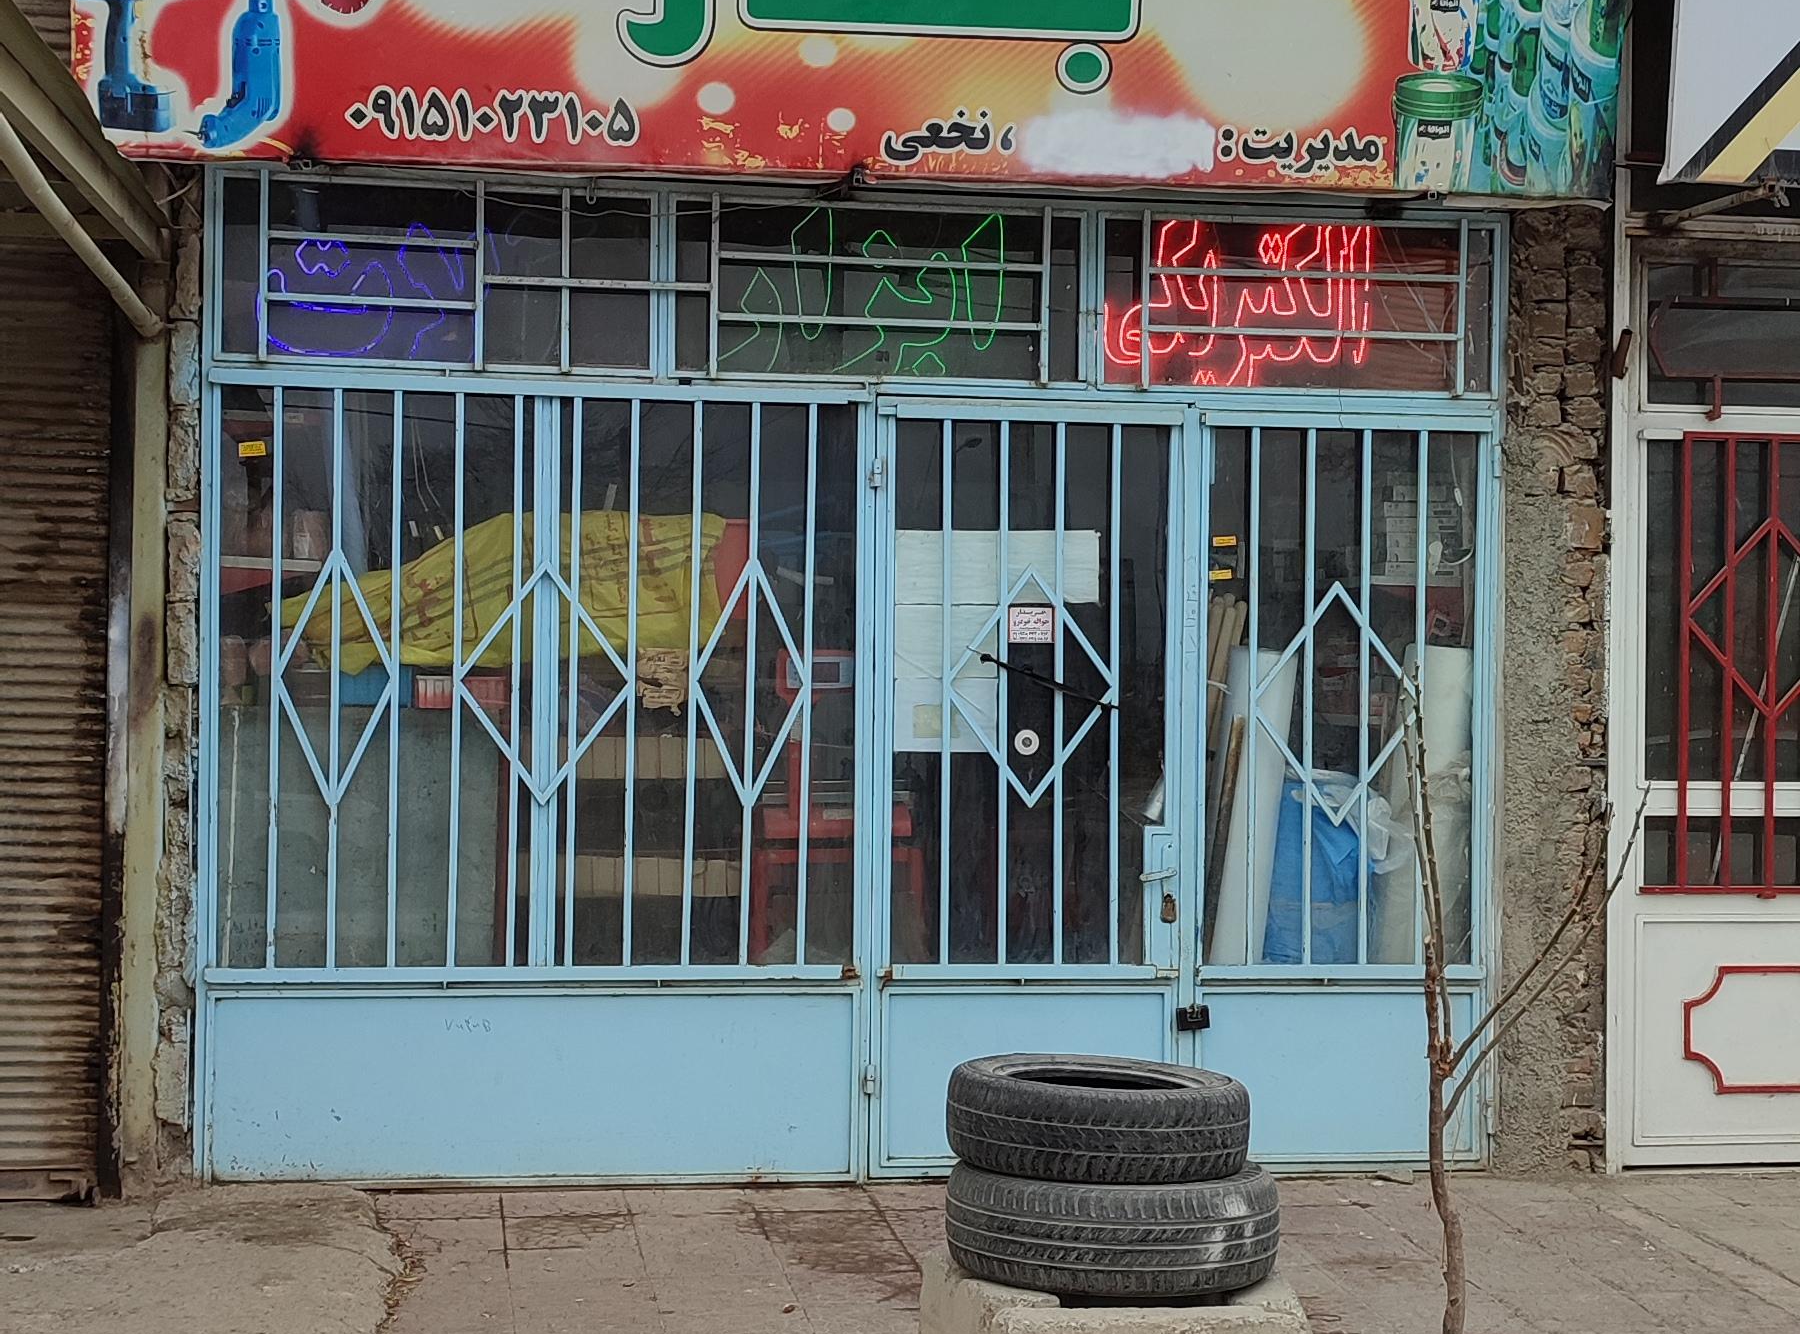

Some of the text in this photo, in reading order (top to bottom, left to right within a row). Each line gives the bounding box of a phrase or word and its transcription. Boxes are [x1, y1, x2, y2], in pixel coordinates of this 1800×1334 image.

[346, 87, 640, 145] ۰۹۱۵۱۰۲۳۱۰۵
[882, 119, 993, 164] نخعی
[714, 207, 1004, 375] ابزار
[1101, 219, 1372, 387] الکتریکی
